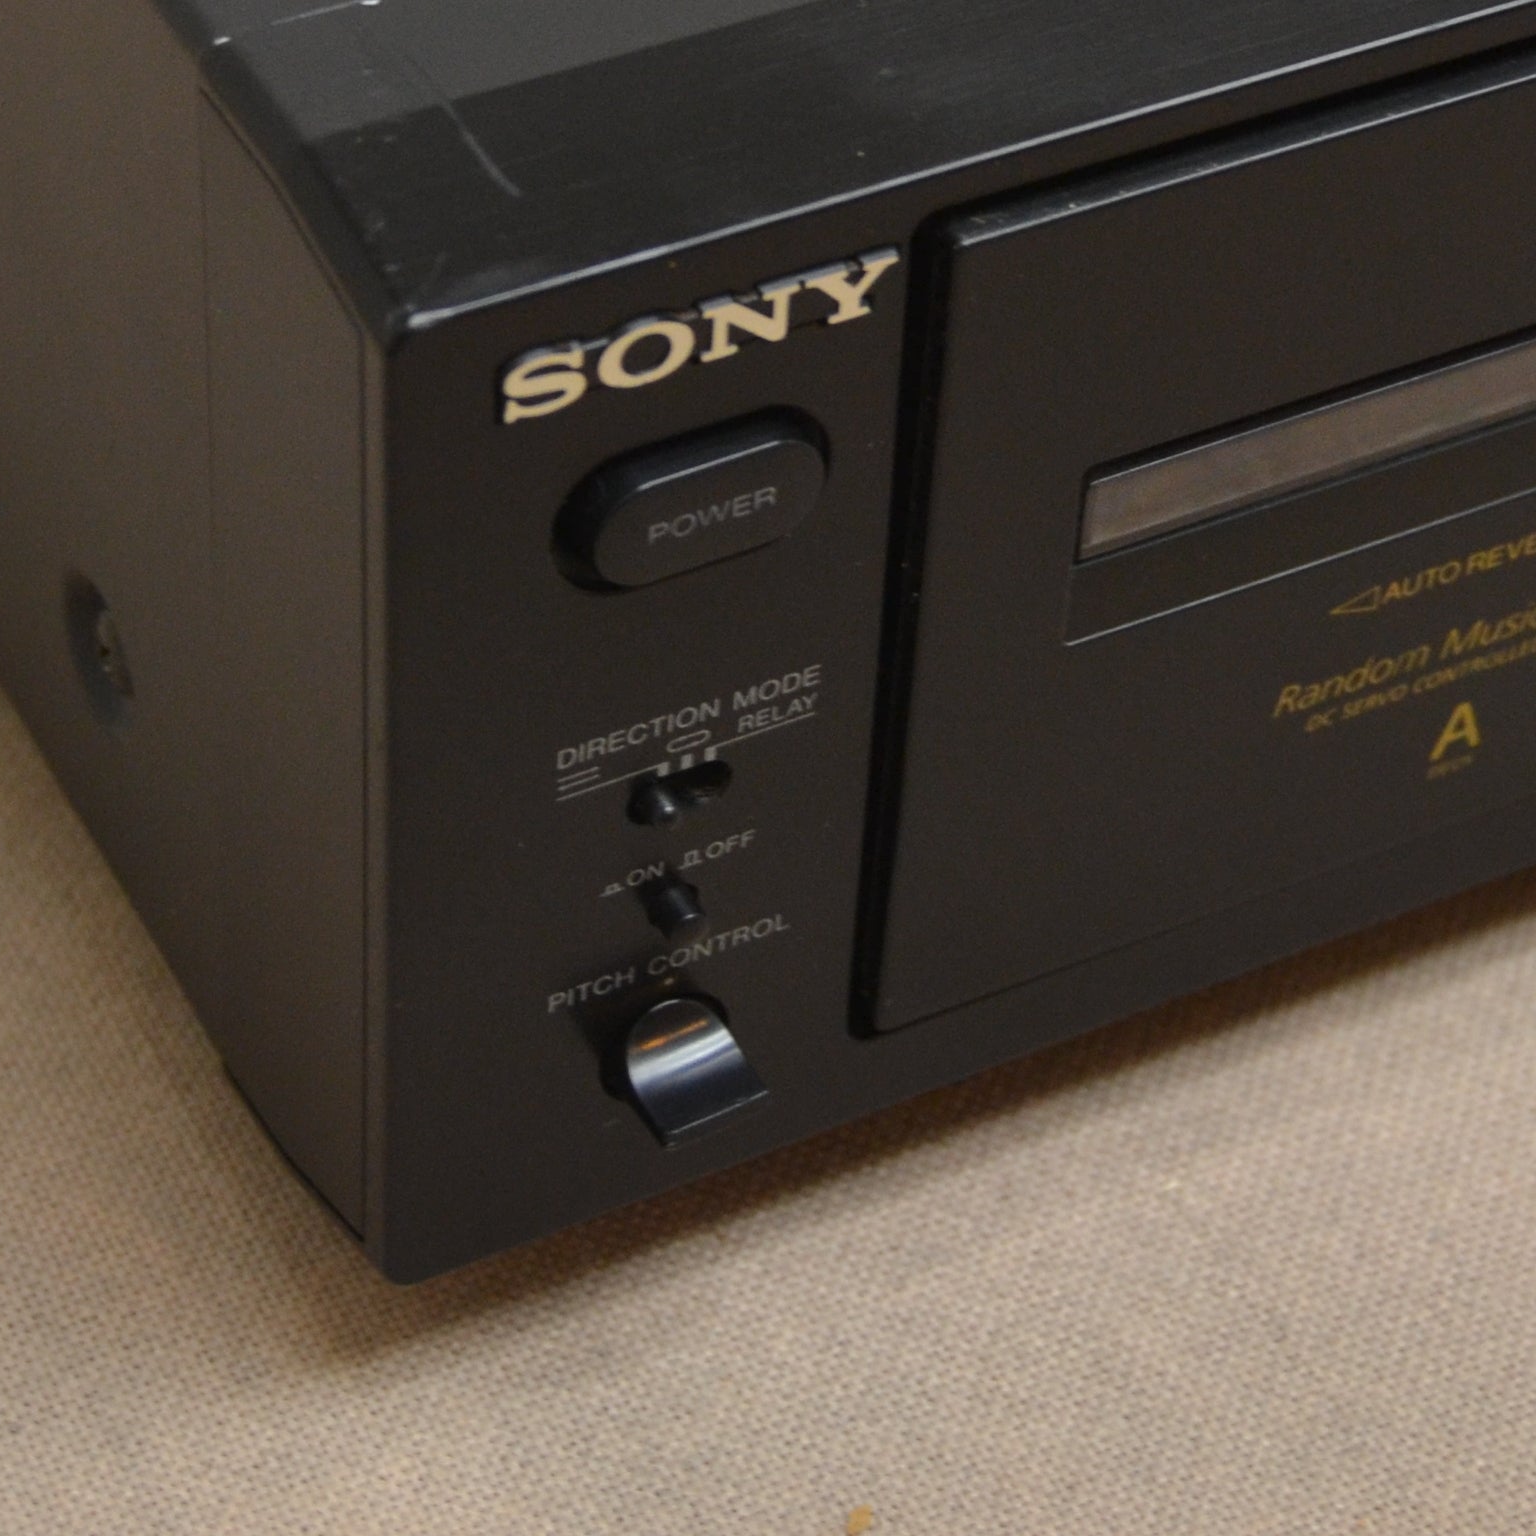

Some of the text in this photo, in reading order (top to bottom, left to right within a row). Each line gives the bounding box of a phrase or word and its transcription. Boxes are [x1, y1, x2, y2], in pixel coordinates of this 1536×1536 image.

[500, 246, 902, 425] SONY
[646, 485, 778, 547] POWER
[1381, 560, 1462, 605] AUTO
[1272, 641, 1434, 719] Random
[1340, 683, 1409, 721] SERVO
[556, 664, 823, 771] DIRECTION MODE
[737, 692, 819, 734] RELAY
[1426, 700, 1483, 763] A
[626, 860, 667, 889] ON
[705, 829, 758, 862] OFF
[547, 913, 792, 1014] PITCH CONTROL
